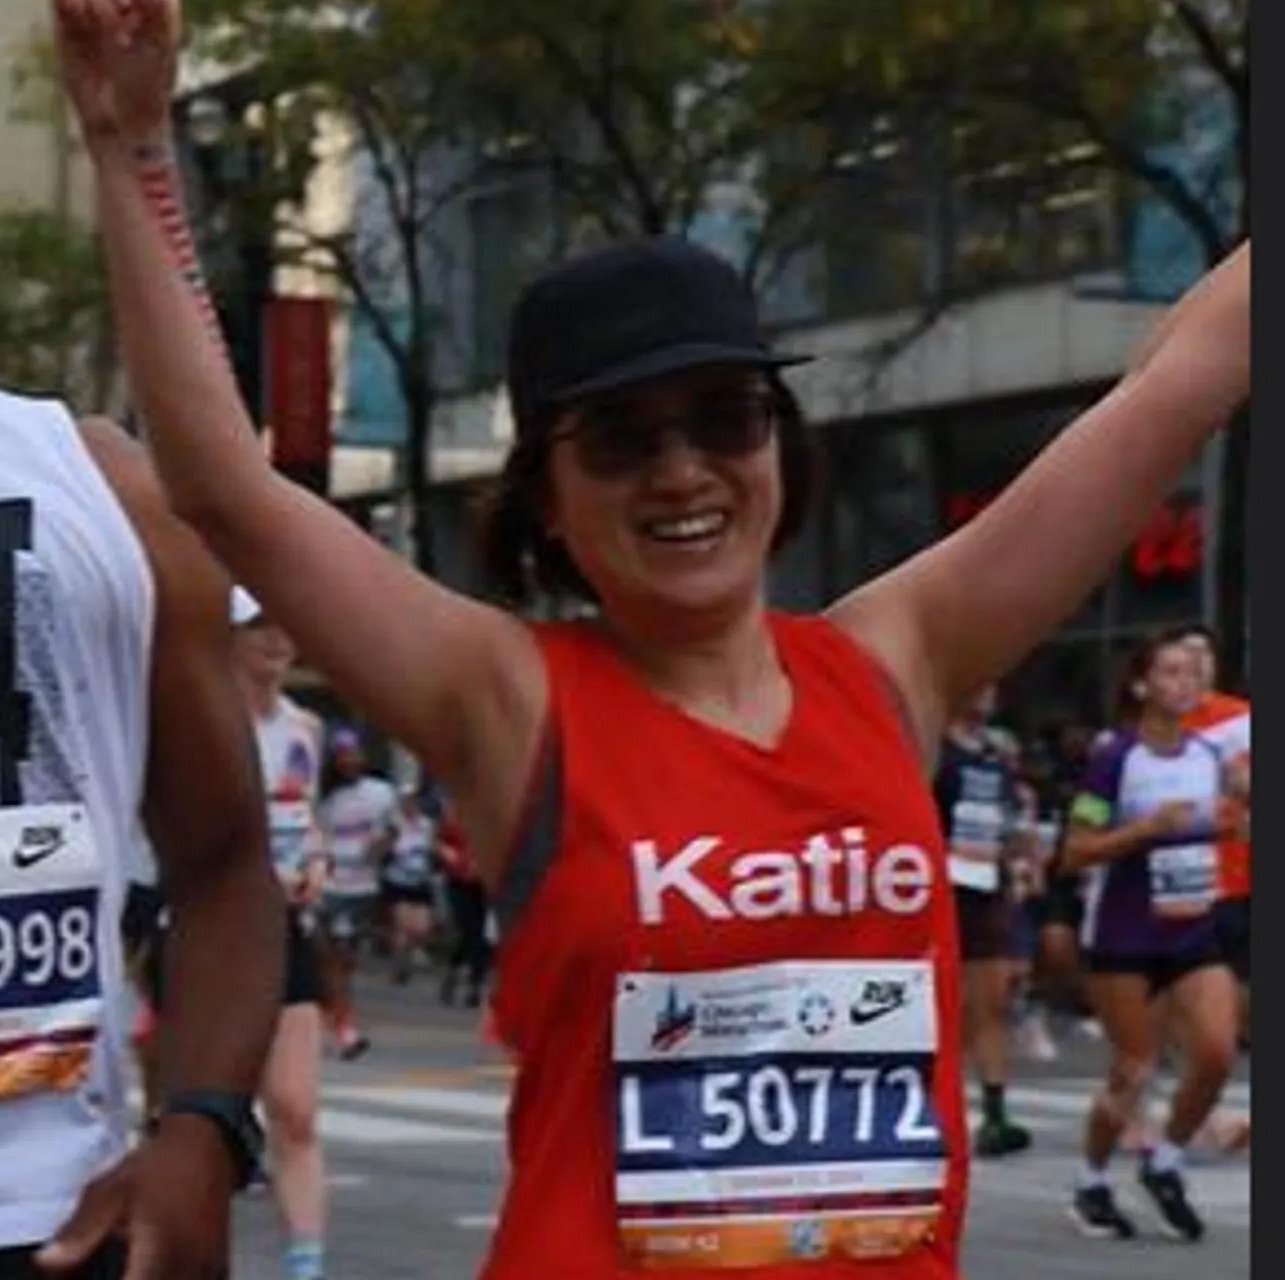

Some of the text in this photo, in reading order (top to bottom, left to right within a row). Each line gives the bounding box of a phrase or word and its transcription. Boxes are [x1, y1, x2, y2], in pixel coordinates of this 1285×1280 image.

[630, 826, 933, 926] Katie
[621, 1065, 941, 1154] L 50772
